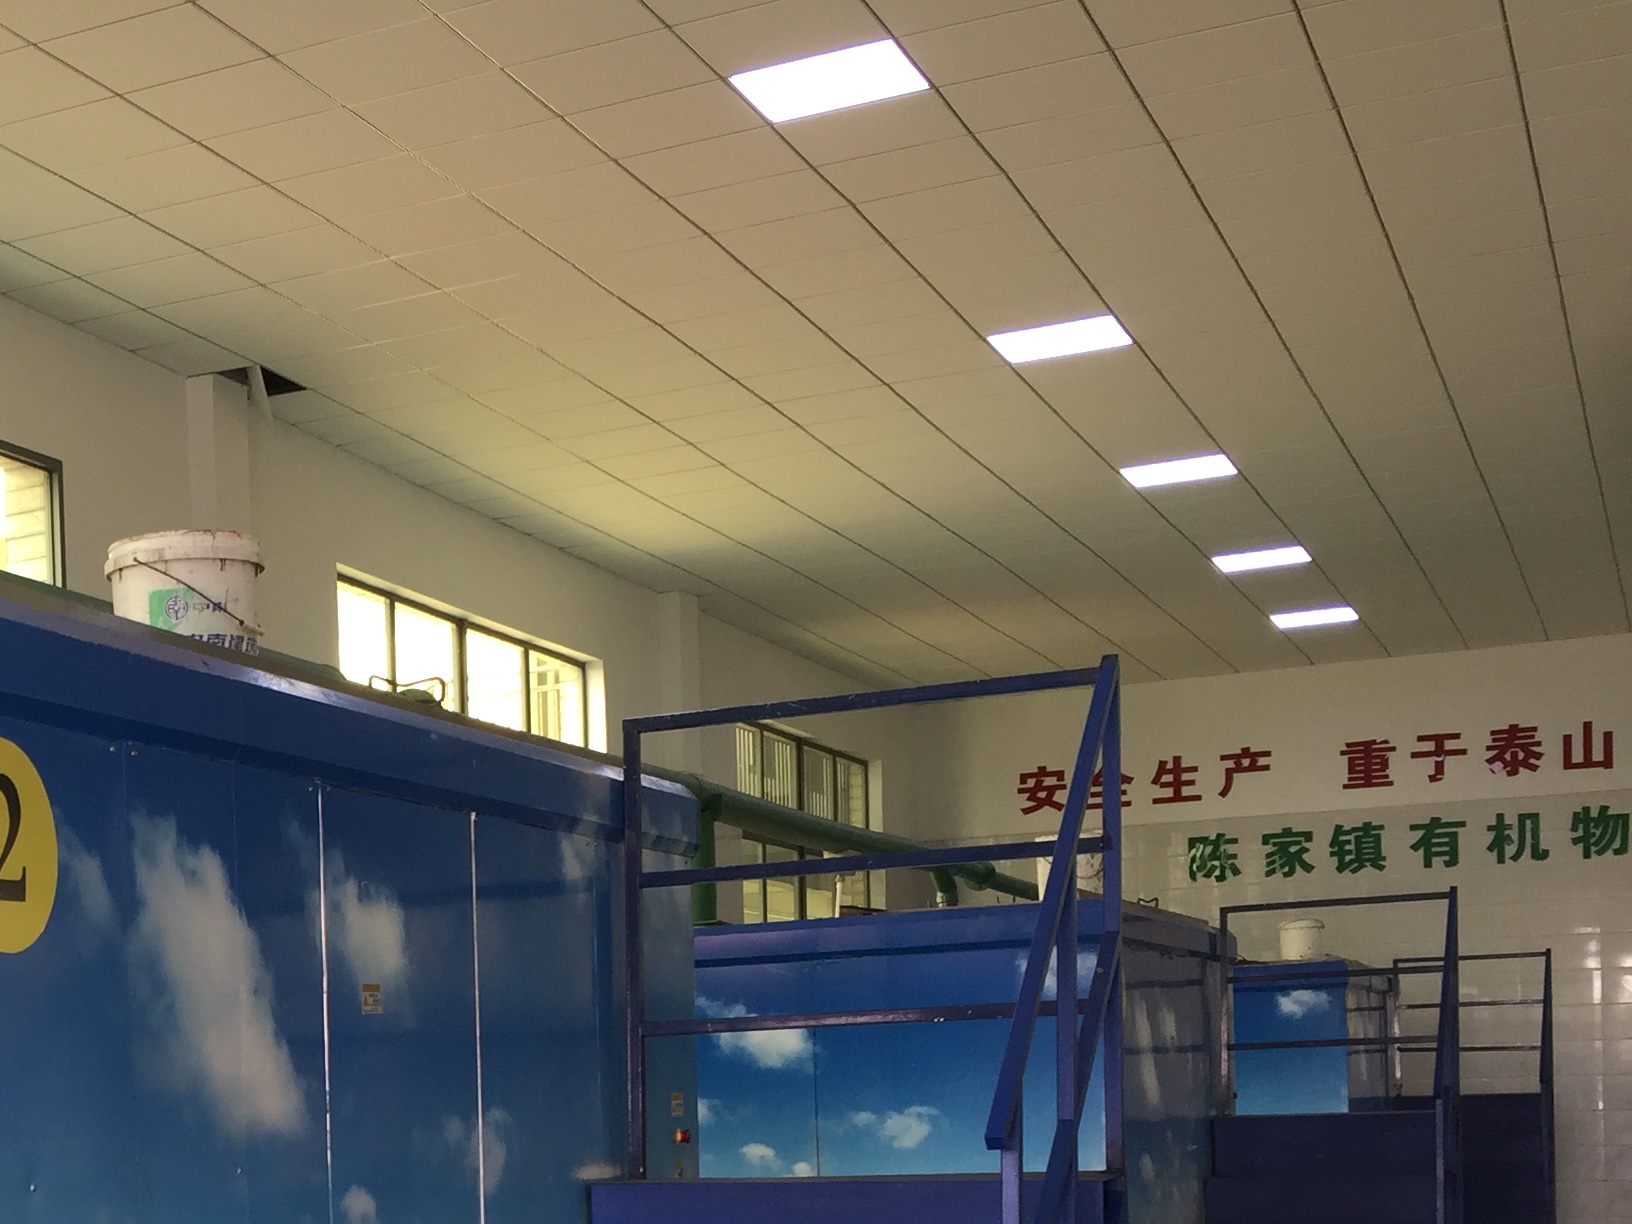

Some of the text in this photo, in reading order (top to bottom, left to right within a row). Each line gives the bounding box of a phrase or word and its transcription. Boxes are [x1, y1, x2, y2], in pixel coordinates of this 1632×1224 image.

[1340, 721, 1614, 790] 重于泰山
[1187, 805, 1631, 884] 陈家镇有机物
